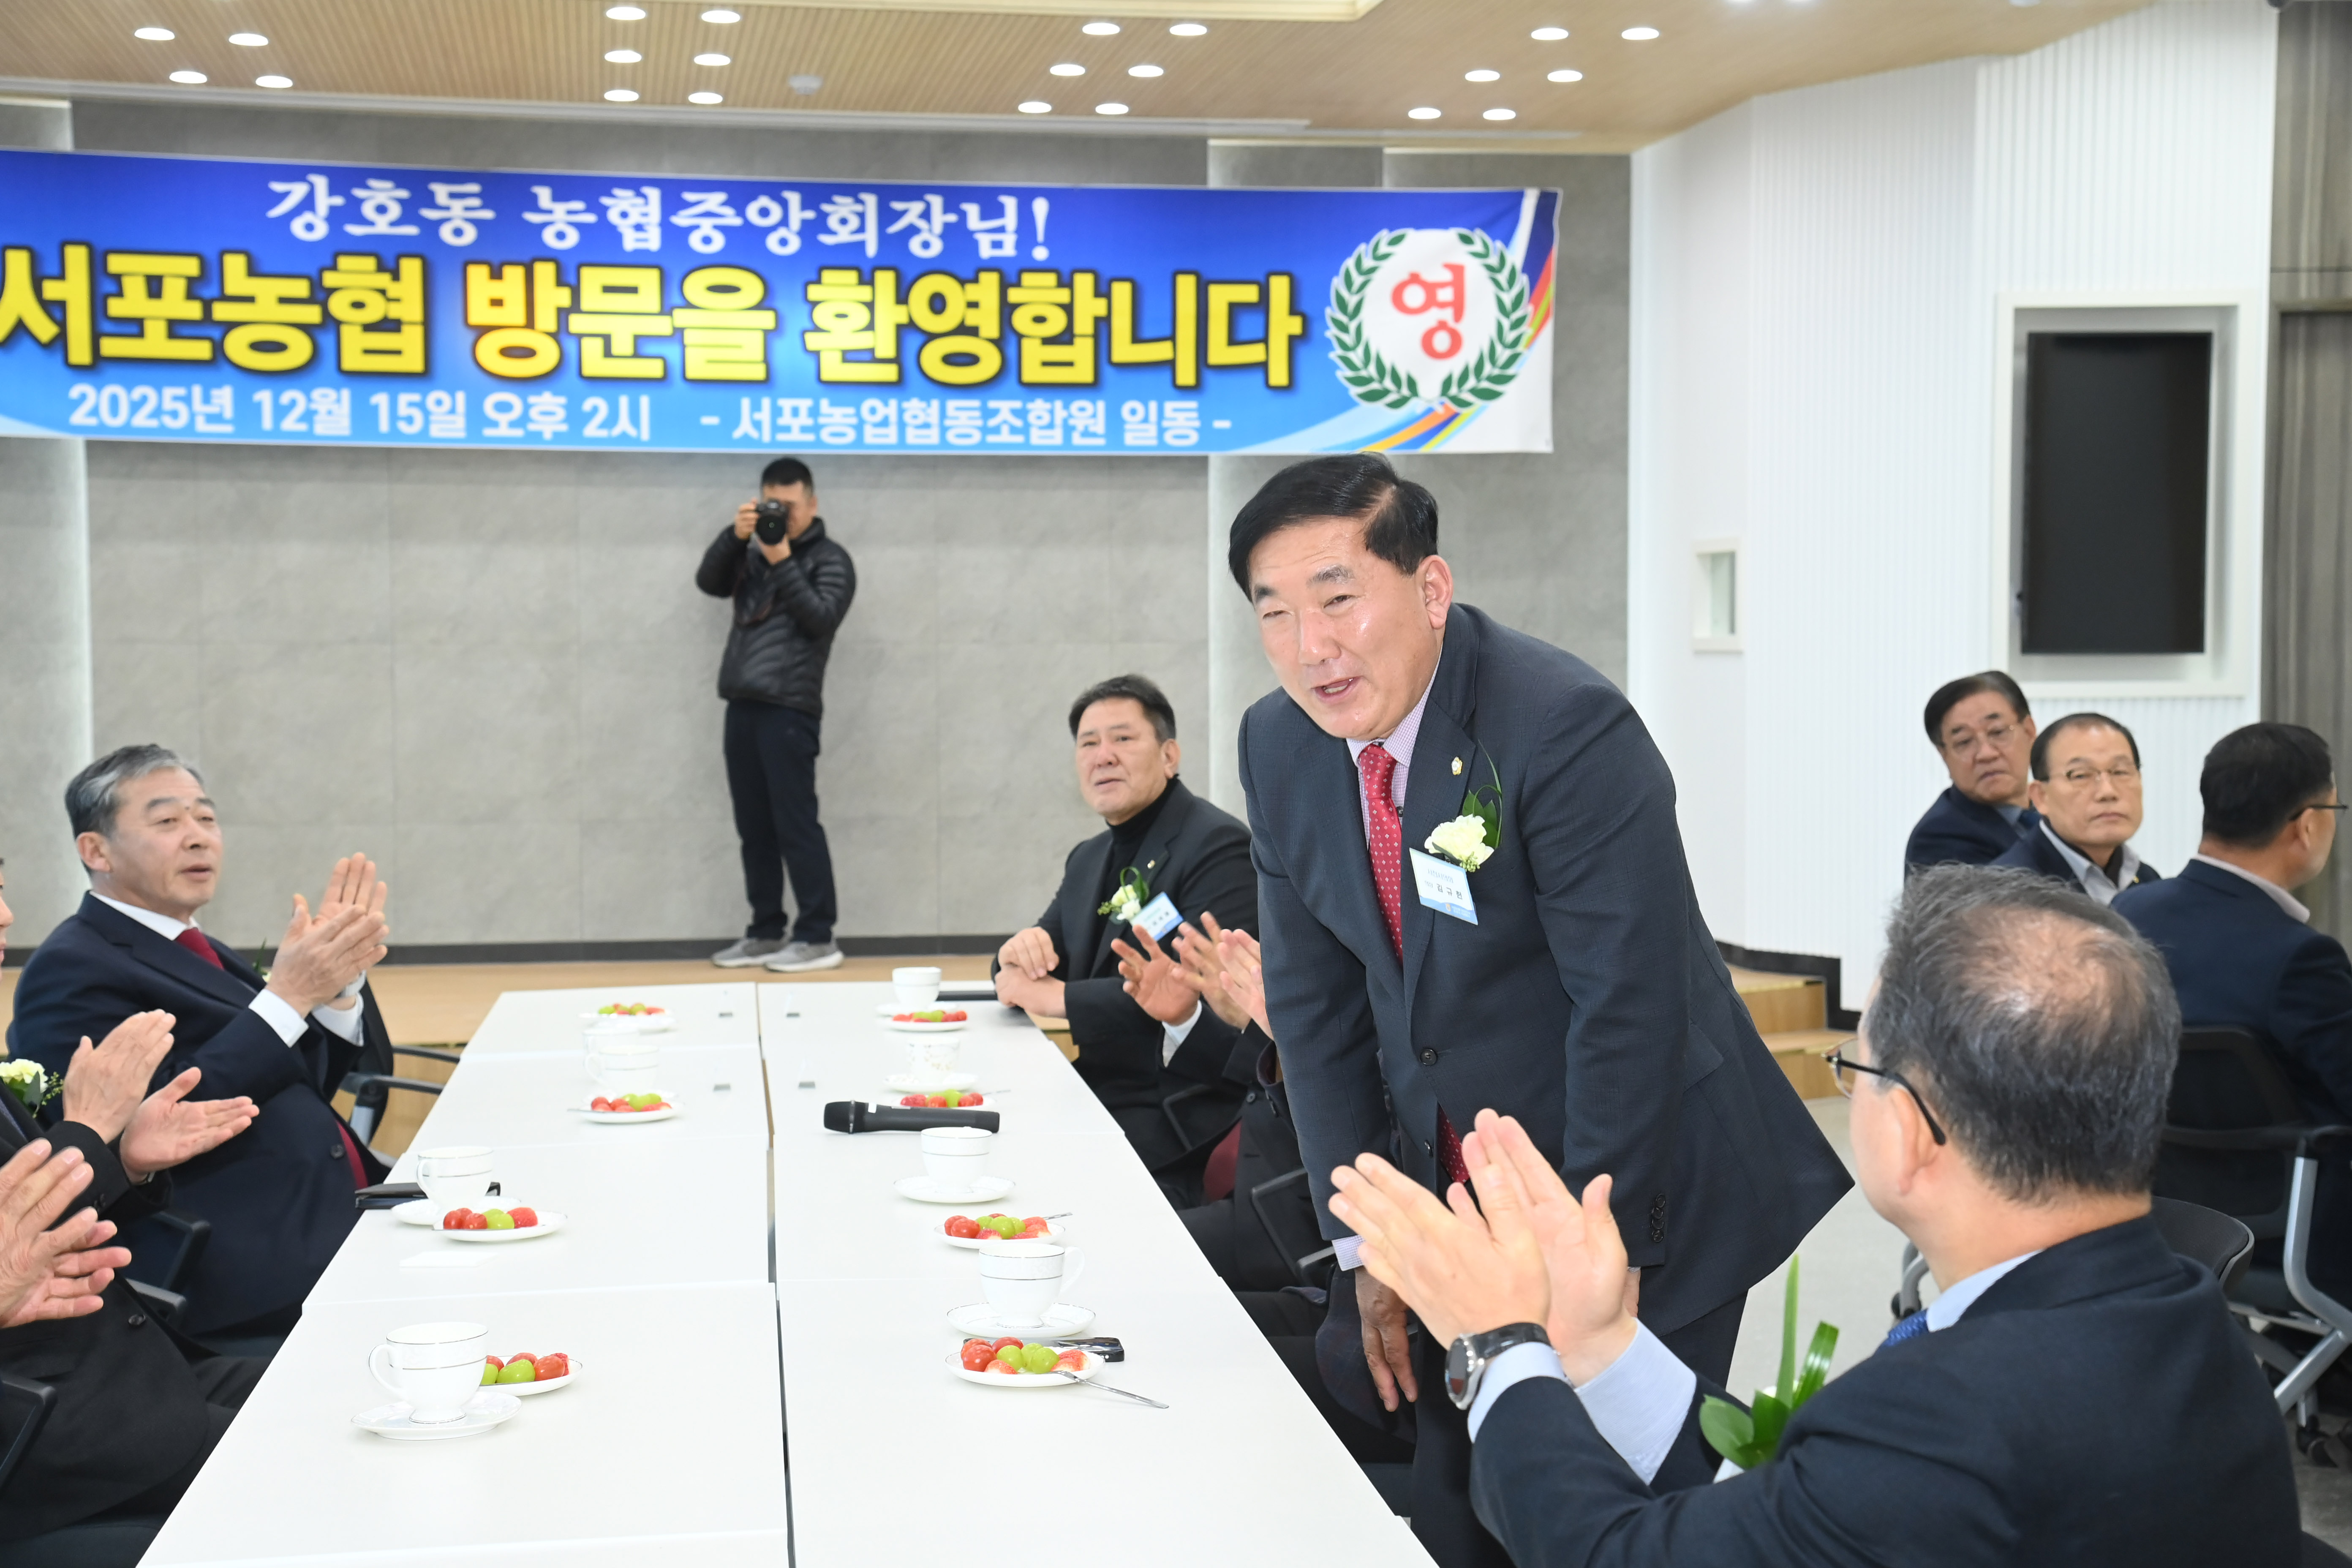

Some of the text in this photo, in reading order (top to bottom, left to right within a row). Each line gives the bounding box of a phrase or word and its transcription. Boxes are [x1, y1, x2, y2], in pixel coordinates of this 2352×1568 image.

[266, 174, 1050, 261] 강호동 농협중앙회장님!
[0, 242, 1304, 387] 서포농협 방문을 환영합니다
[1390, 262, 1467, 361] 영
[68, 382, 651, 442] 2025년 12월 15일 오후 2시
[732, 396, 1106, 446] 서포농업협동조합원
[1120, 399, 1202, 447] 일동
